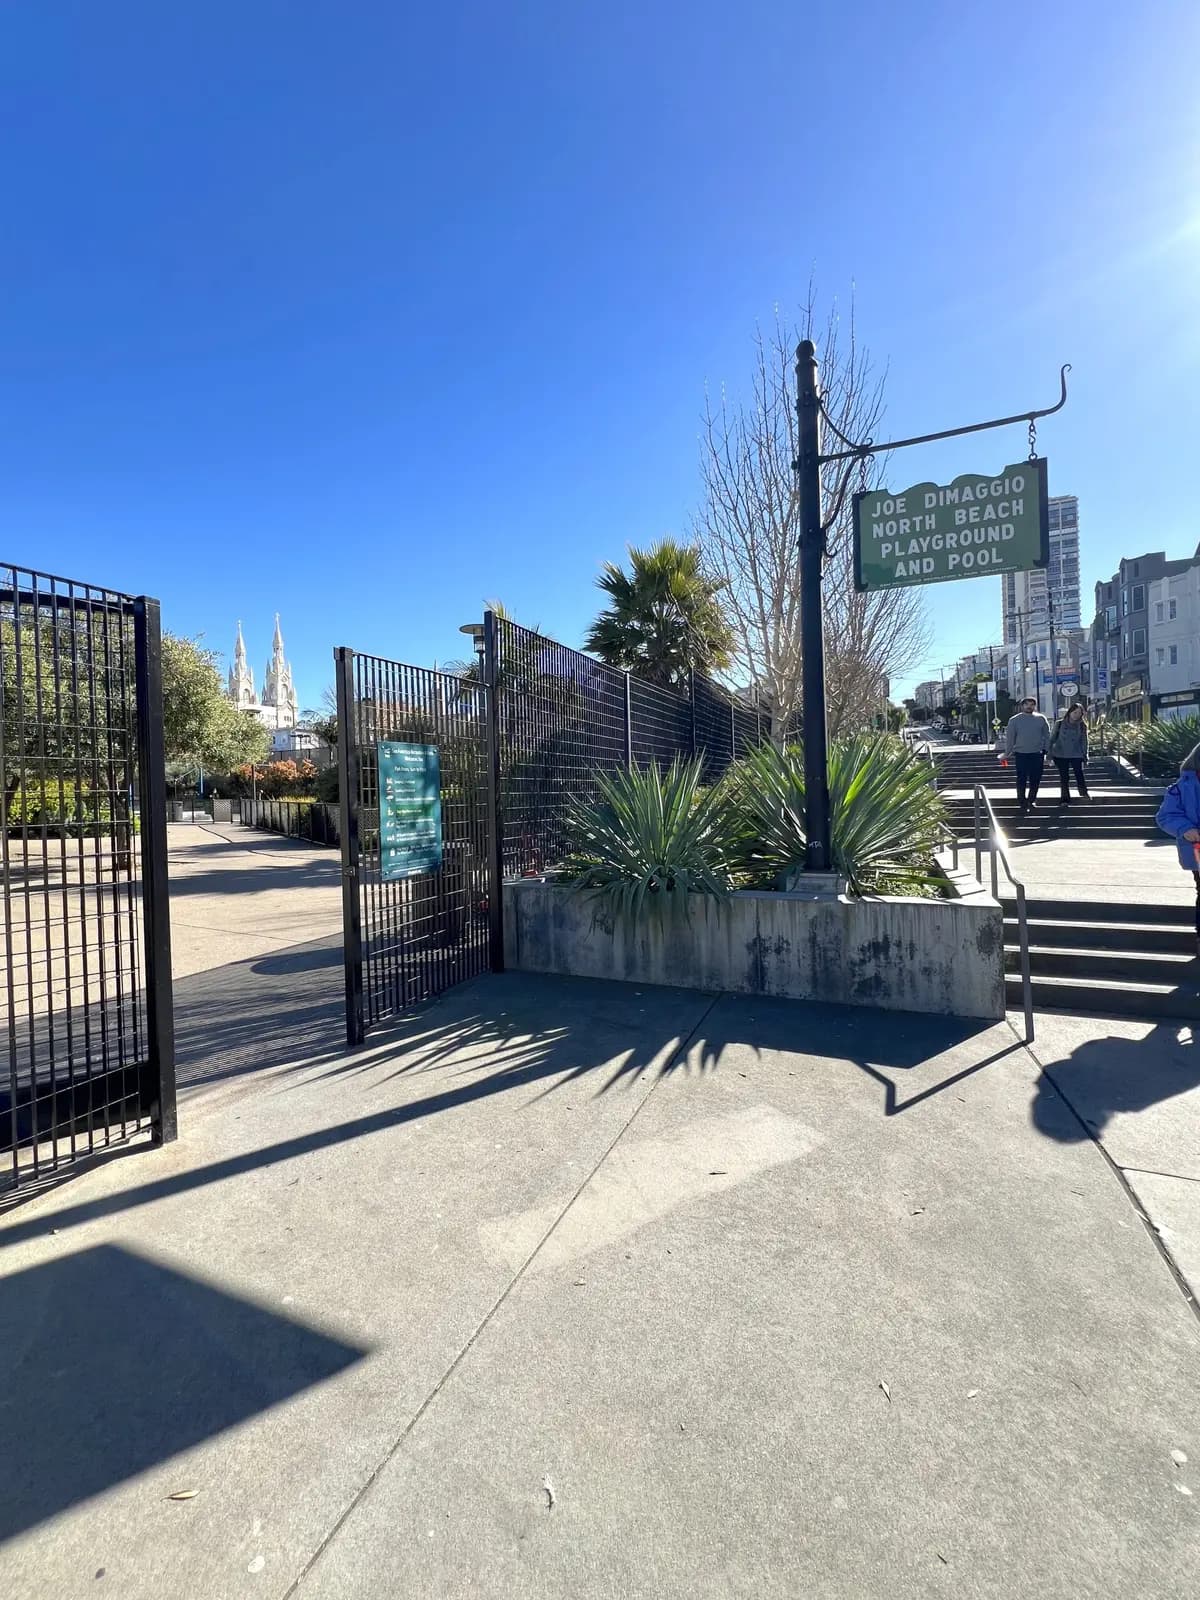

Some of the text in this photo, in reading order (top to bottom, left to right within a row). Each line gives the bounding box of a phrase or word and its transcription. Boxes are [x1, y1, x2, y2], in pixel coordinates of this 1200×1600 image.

[871, 475, 1025, 518] JOE DIMAGGIO
[872, 498, 1024, 539] NORTH BEACH
[881, 523, 1015, 558] PLAYGROUND
[894, 557, 935, 578] AND
[948, 547, 1003, 570] POOL
